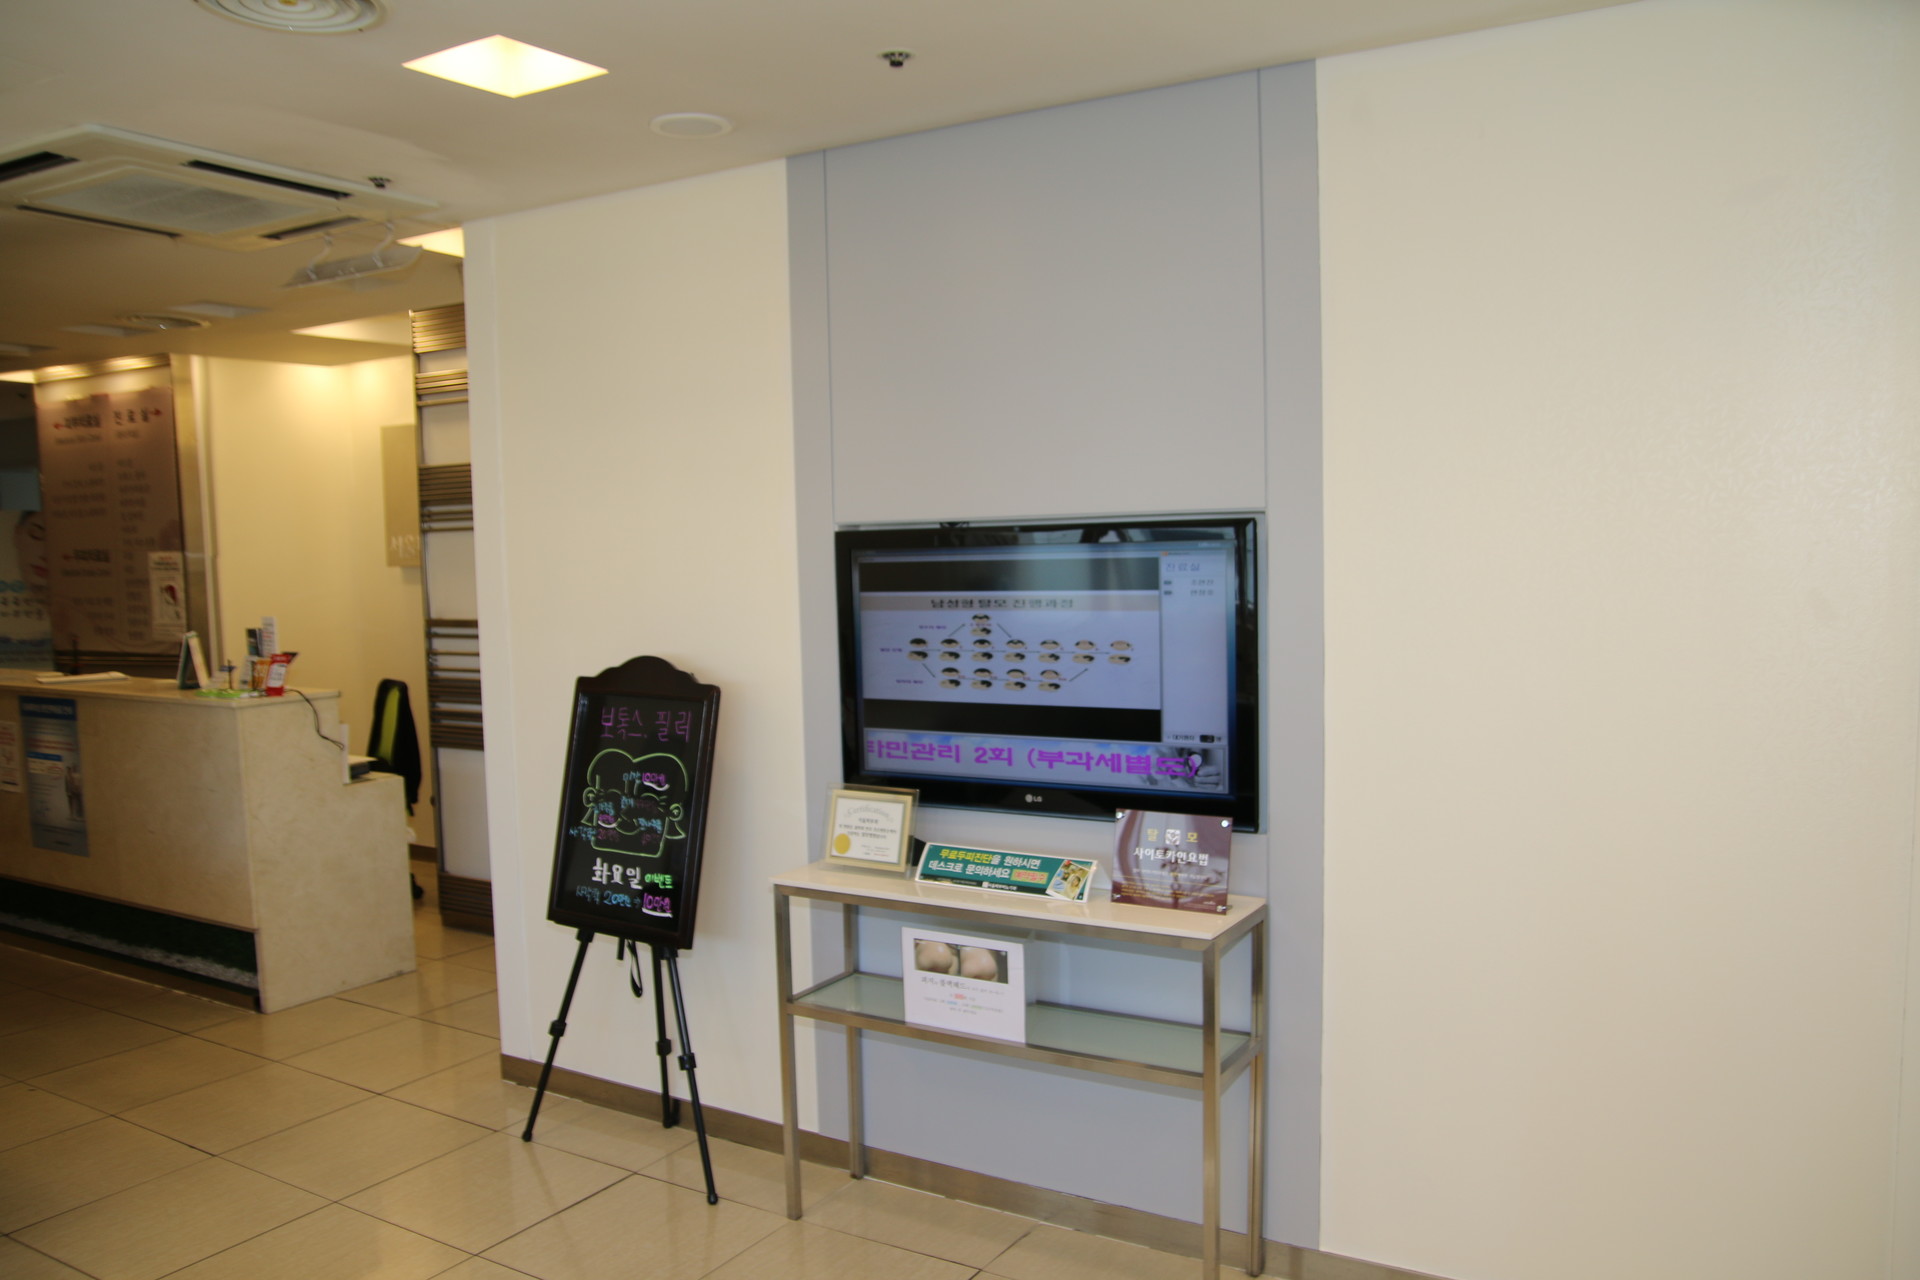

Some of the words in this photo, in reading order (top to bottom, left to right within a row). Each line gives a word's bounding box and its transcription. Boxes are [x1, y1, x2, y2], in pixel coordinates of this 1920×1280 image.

[973, 746, 1014, 768] 2회
[1027, 749, 1199, 778] (부과세별도)
[1186, 832, 1199, 843] 모
[939, 848, 1001, 866] 무료두피진단을
[1003, 856, 1041, 870] 원하시면
[1133, 847, 1210, 866] 사이토카인요법
[591, 857, 643, 890] 화요일
[928, 860, 963, 873] 데스크로
[965, 863, 1011, 879] 문의하세요
